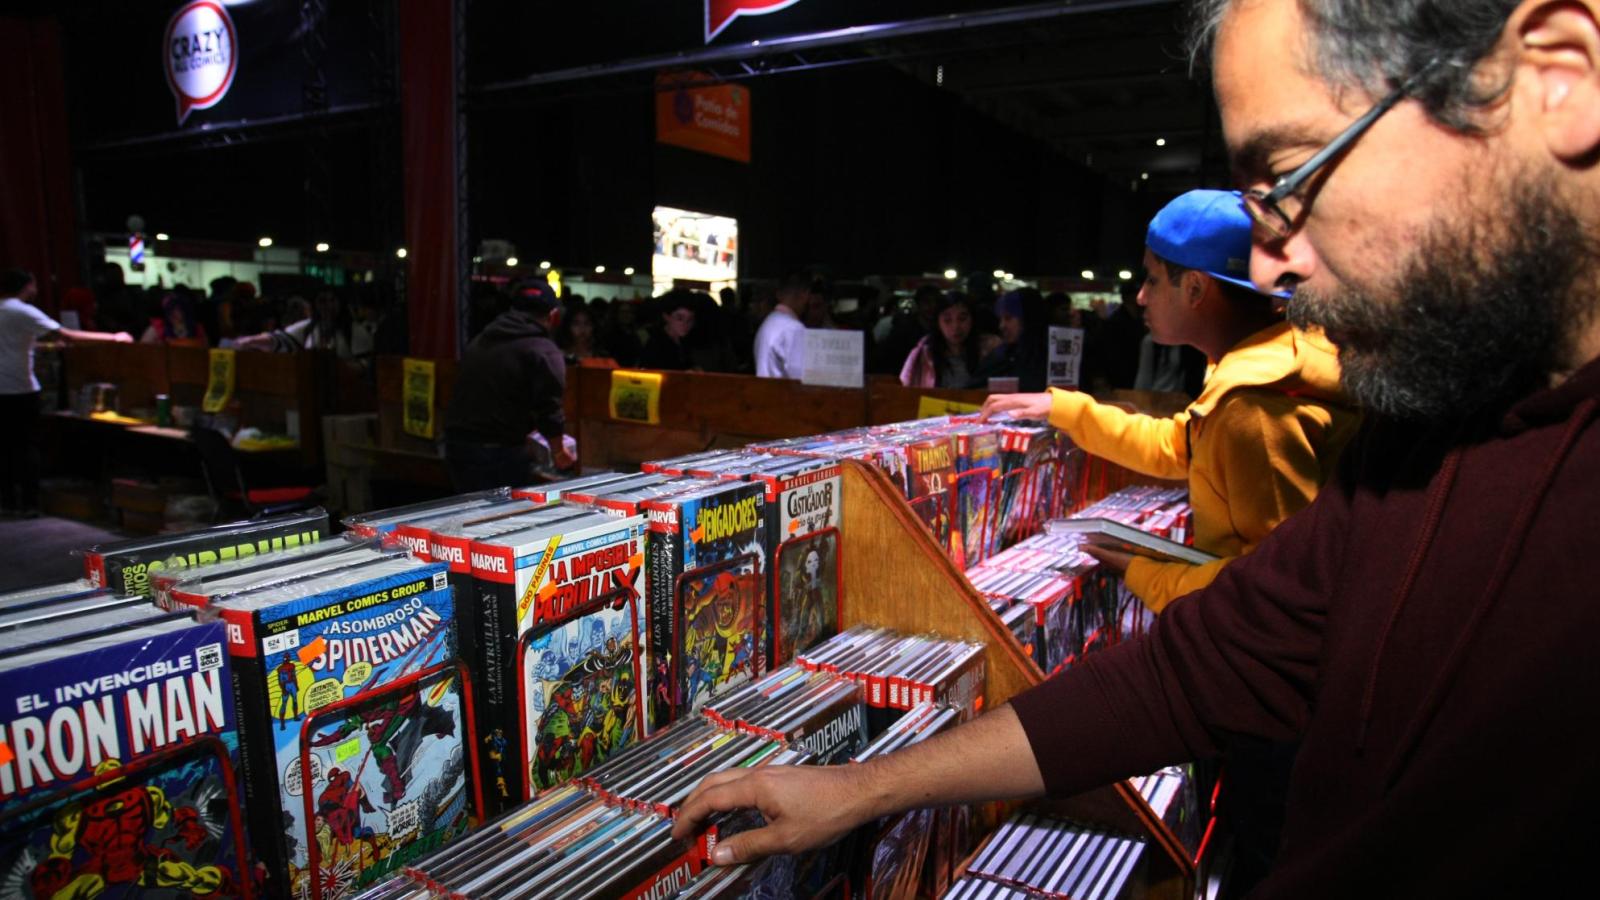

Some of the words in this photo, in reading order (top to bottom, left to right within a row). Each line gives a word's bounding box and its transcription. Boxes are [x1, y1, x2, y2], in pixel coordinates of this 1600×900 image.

[172, 28, 224, 60] CRAZY
[648, 508, 678, 524] MARVEL
[787, 482, 833, 518] CASTIGADOR
[702, 496, 757, 544] VENGADORES
[431, 543, 465, 563] MARVEL
[471, 552, 508, 573] MARVEL
[549, 560, 568, 585] LA
[571, 540, 638, 580] IMPOSIBLE
[297, 606, 344, 627] MARVEL
[346, 592, 388, 613] COMICS
[391, 581, 427, 599] GROUP
[330, 597, 422, 634] ASOMBROSO
[16, 694, 49, 714] EL
[55, 655, 193, 703] INVENCIBLE
[126, 668, 225, 753] MAN
[637, 862, 694, 900] MÉRICA
